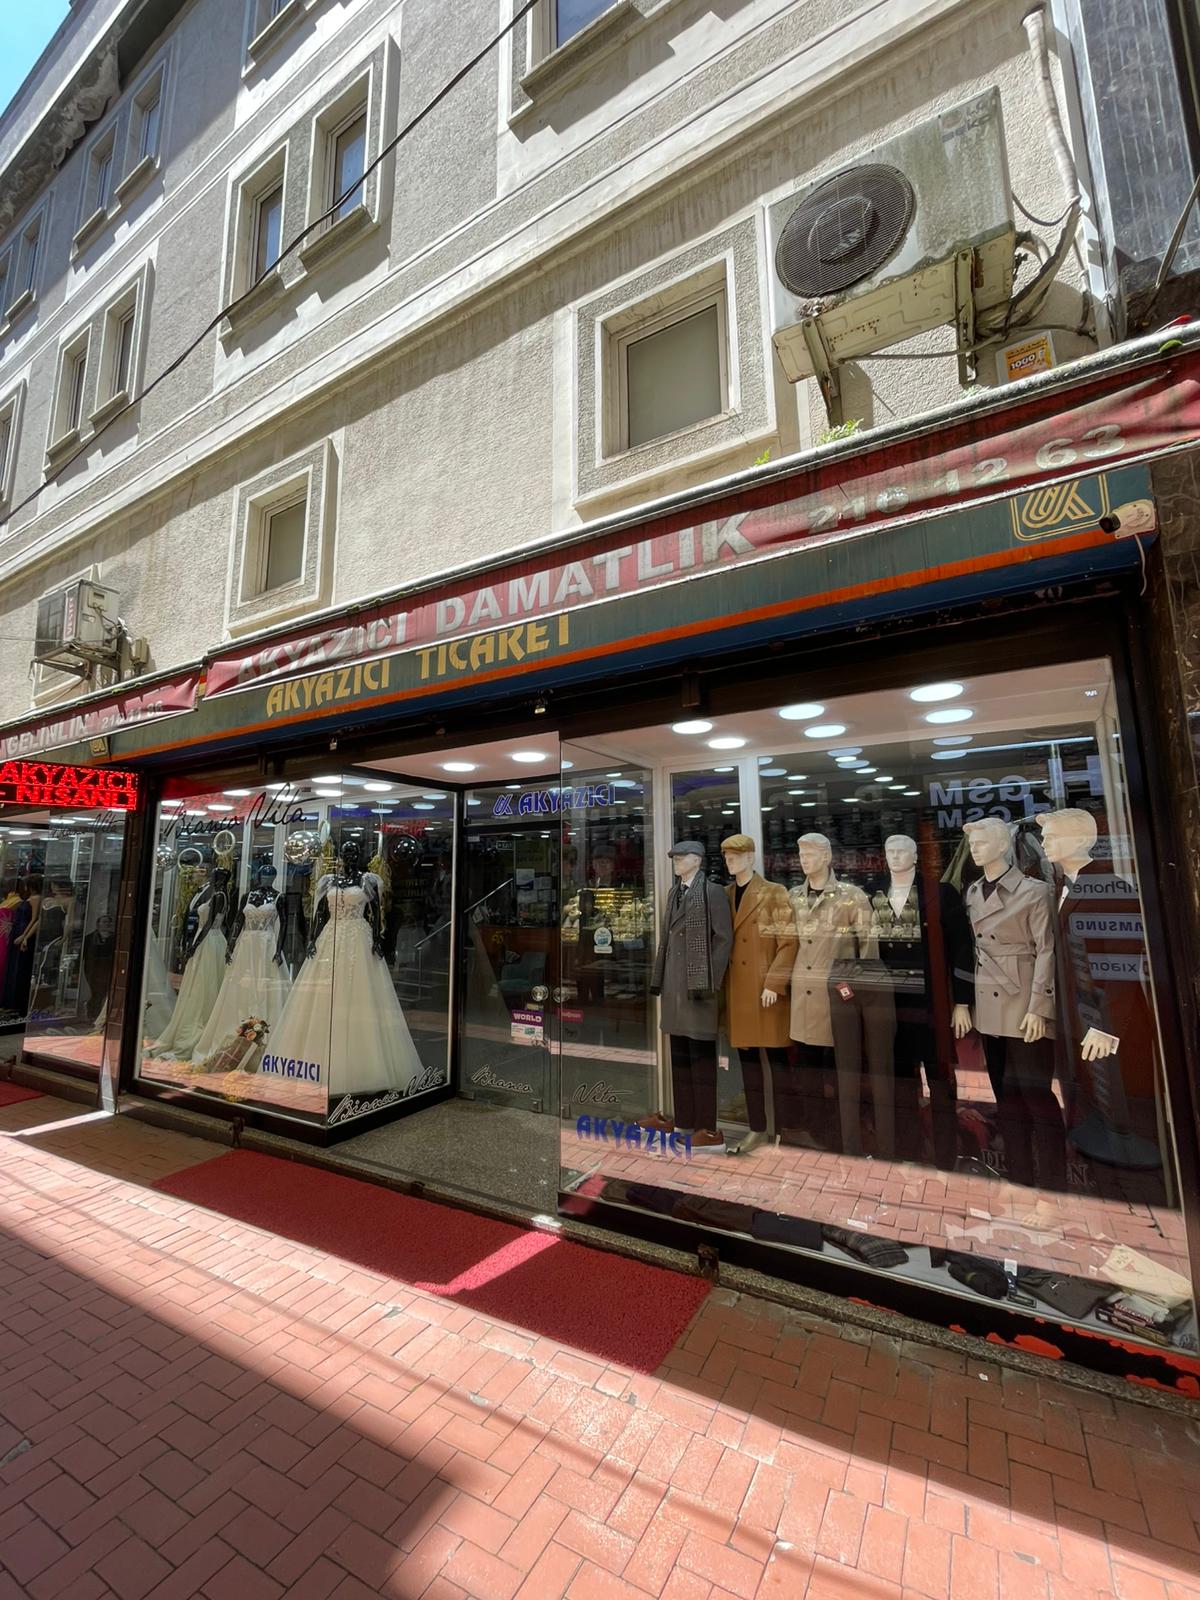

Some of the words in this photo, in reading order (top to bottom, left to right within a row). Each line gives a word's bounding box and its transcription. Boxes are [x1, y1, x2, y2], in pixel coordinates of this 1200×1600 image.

[436, 512, 756, 634] DAMATLIK
[935, 458, 1010, 495] 12
[1036, 424, 1126, 471] 63
[266, 659, 390, 717] AKYAZICI
[0, 761, 135, 791] AKYAZICI
[518, 784, 616, 816] AKYAZICI
[513, 1012, 542, 1023] WORLD
[262, 1054, 321, 1082] AKYAZICI
[576, 1115, 692, 1161] AKYAZICI
